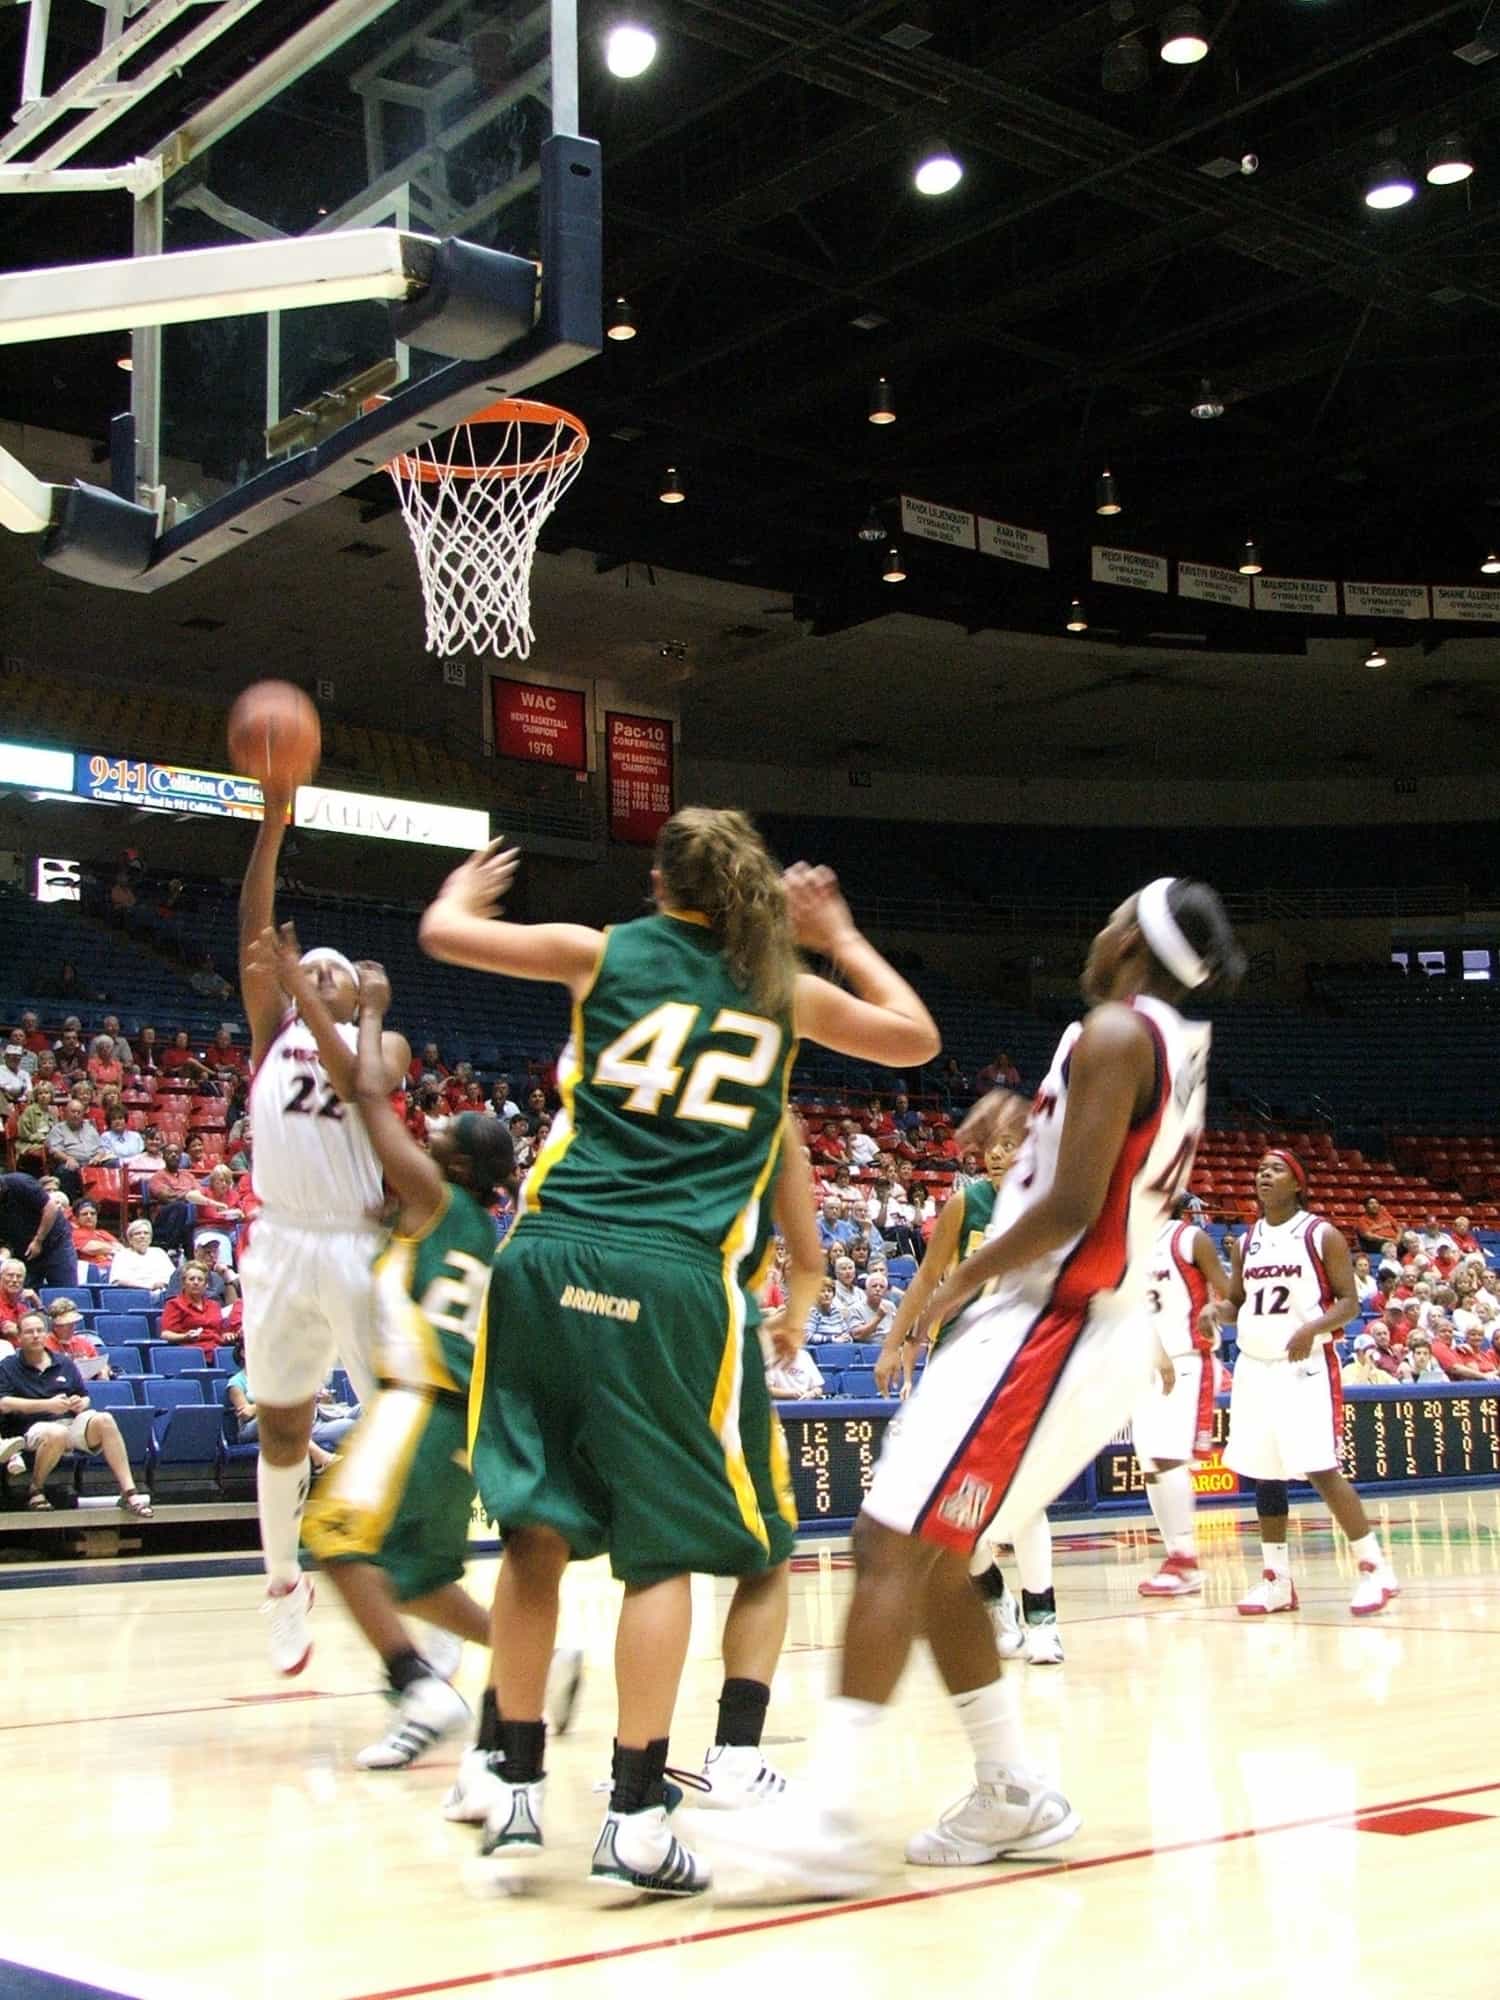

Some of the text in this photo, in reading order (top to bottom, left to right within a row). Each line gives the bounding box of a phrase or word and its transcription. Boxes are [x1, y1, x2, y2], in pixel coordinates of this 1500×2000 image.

[520, 691, 557, 712] WAC
[591, 1001, 782, 1131] 42
[1253, 1286, 1290, 1316] 12
[1396, 1401, 1414, 1420] 10
[1423, 1400, 1442, 1418] 20
[1451, 1399, 1471, 1417] 25
[1480, 1398, 1499, 1417] 42
[803, 1422, 829, 1444] 12
[845, 1420, 873, 1442] 20
[1461, 1417, 1471, 1434] 0
[1462, 1435, 1472, 1452] 0
[801, 1443, 873, 1467] 20 6
[816, 1466, 874, 1489] 2 2
[1376, 1459, 1387, 1477] 0
[816, 1491, 830, 1513] 0
